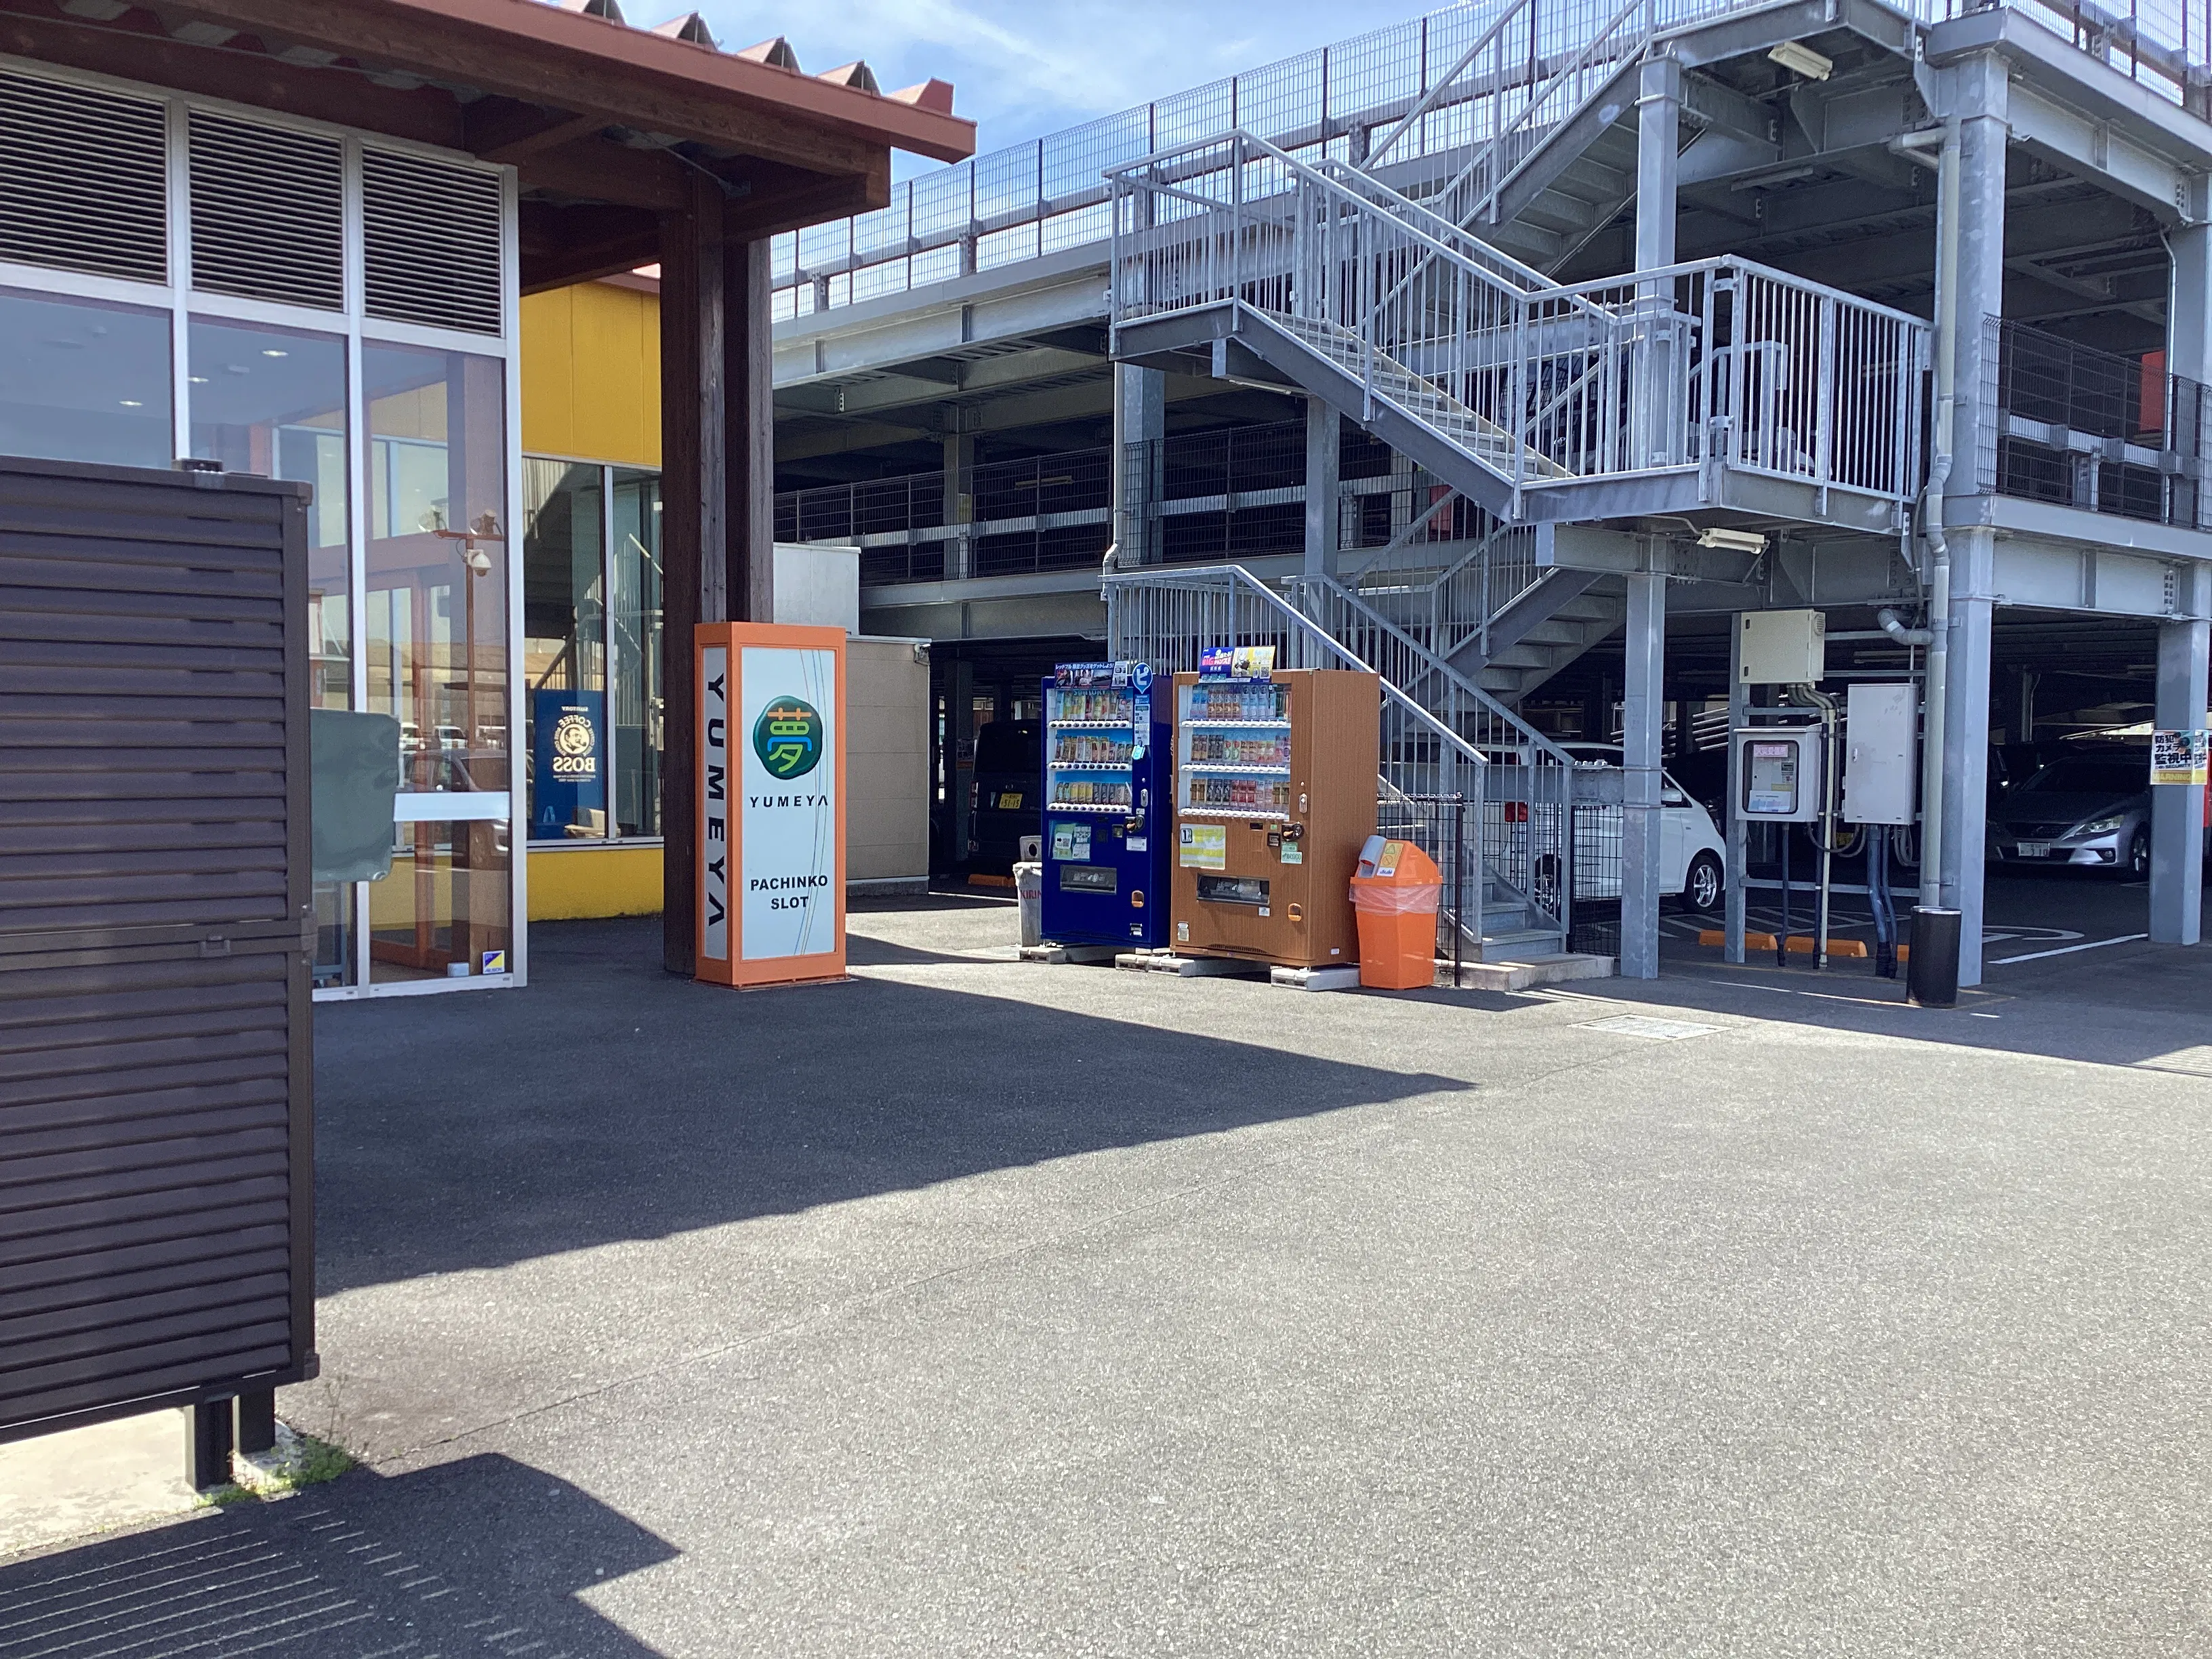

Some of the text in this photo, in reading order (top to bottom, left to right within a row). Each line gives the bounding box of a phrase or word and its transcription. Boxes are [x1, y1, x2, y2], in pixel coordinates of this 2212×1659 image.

[1136, 666, 1149, 685] ピ
[767, 707, 813, 773] 夢
[2156, 743, 2180, 752] カメラ
[2155, 752, 2192, 765] 監視中
[2153, 773, 2191, 781] WARNING
[708, 672, 725, 927] YUMEYA
[750, 795, 828, 808] YUMEYA
[750, 875, 828, 891] PACHINKO
[771, 895, 809, 910] SLOT
